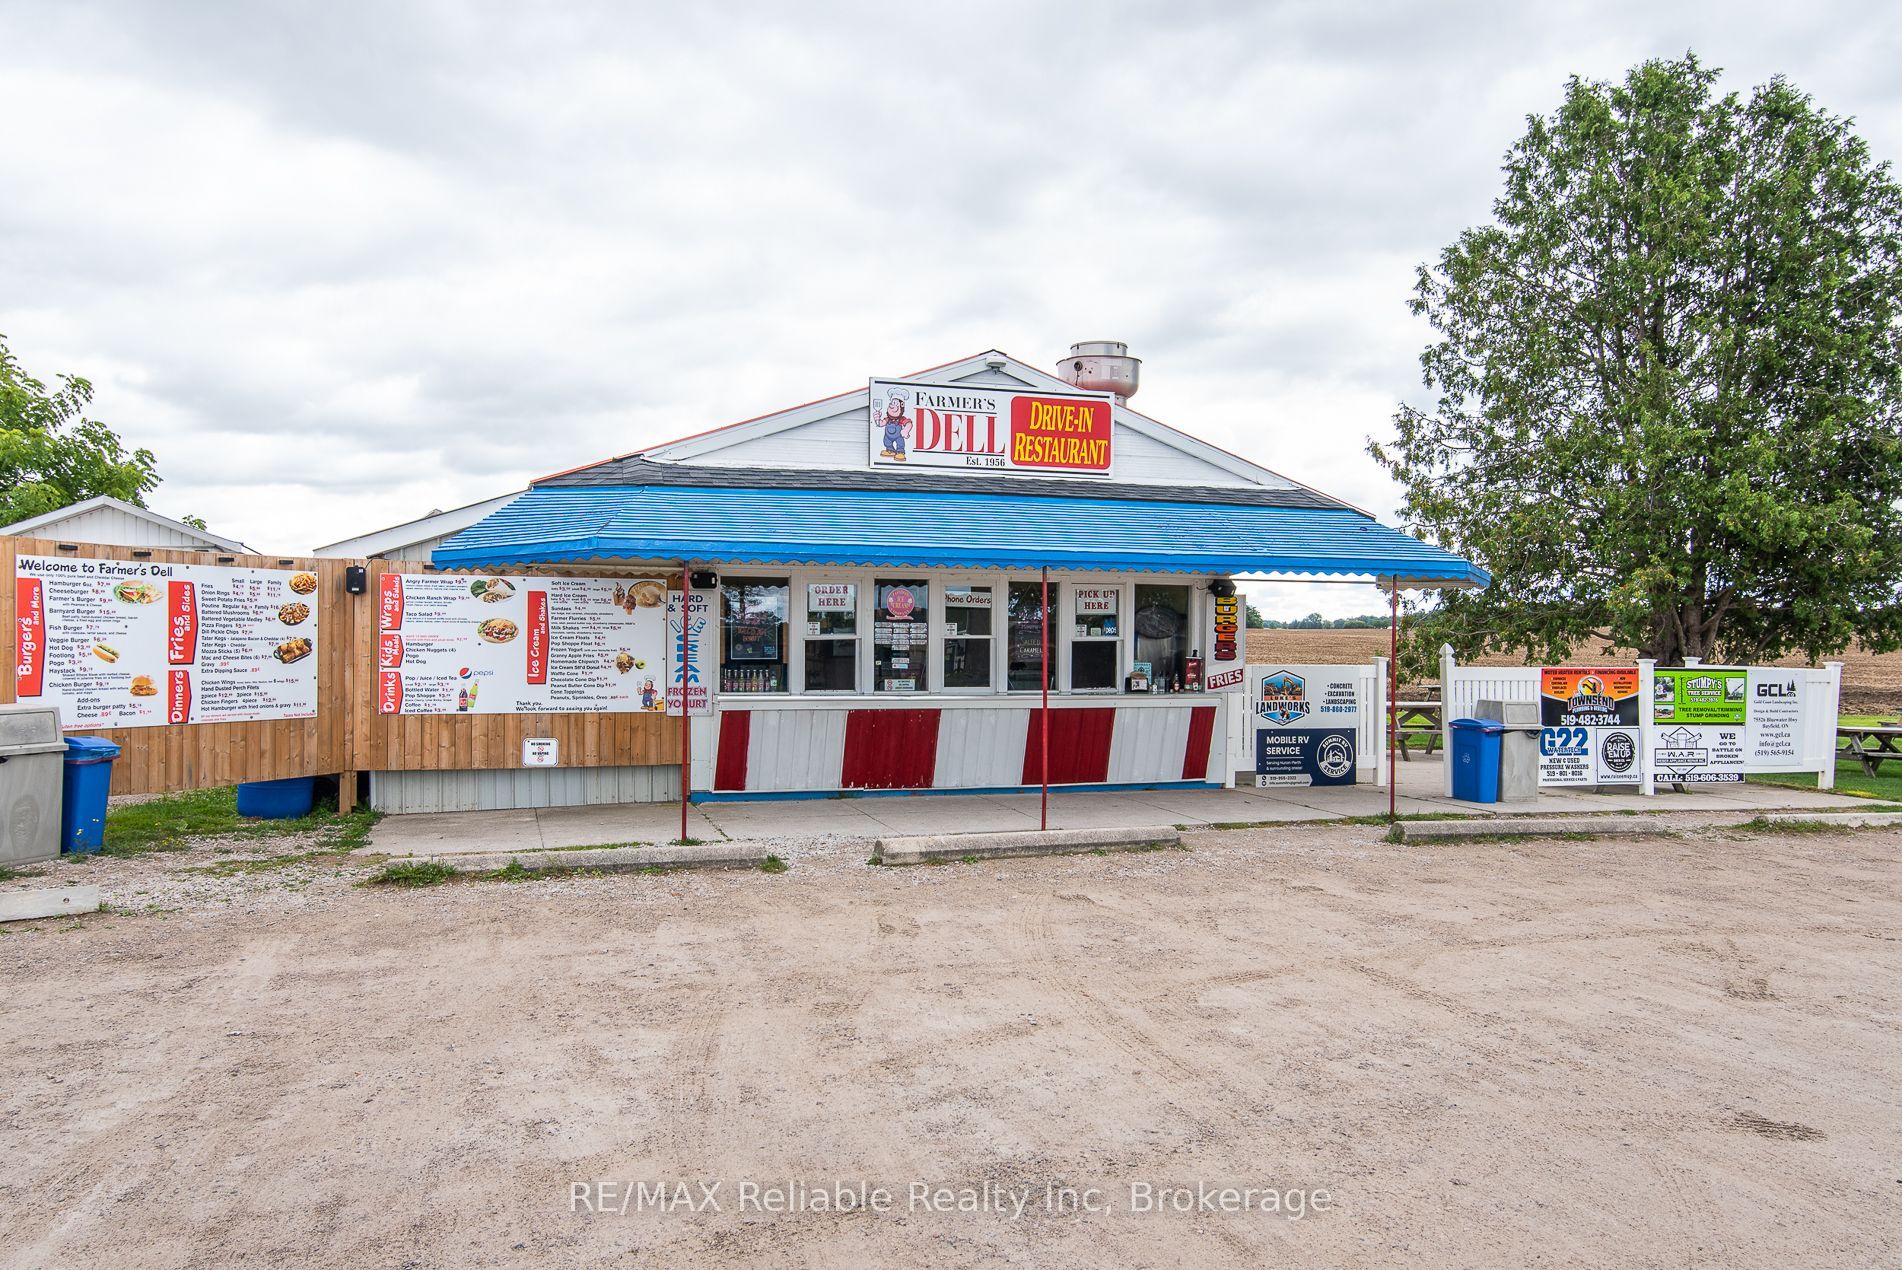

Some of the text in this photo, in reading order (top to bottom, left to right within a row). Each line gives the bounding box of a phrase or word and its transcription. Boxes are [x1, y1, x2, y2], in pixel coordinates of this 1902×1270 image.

[915, 391, 996, 410] FARMER'S
[1029, 401, 1095, 433] DRIVE-IN
[913, 407, 1006, 454] DELL
[1013, 432, 1108, 466] RESTAURANT
[966, 456, 1005, 467] Est. 1956
[19, 559, 78, 573] Welcome
[82, 561, 95, 574] to
[99, 562, 147, 576] Farmer's
[151, 565, 173, 577] Dell
[182, 584, 191, 612] Sides
[814, 585, 848, 594] ORDER
[30, 586, 40, 626] and More
[668, 604, 676, 612] &
[818, 598, 846, 606] HERE
[966, 594, 992, 604] Orders
[381, 590, 392, 629] Wraps
[1214, 597, 1238, 660] BURGERS
[17, 617, 37, 677] Burgers
[169, 617, 185, 661] Fries
[380, 640, 393, 666] Kids
[528, 628, 540, 678] Ice Cream
[1210, 670, 1242, 688] FRIES
[1687, 676, 1722, 689] STUMPY'S
[172, 672, 184, 722] Dinners
[382, 672, 396, 713] Drinks
[1757, 684, 1786, 696] GCL
[668, 700, 708, 708] YOURT
[1256, 702, 1310, 714] LANDWORKS
[1568, 694, 1615, 711] TOWNSEND
[1266, 736, 1296, 744] MOBILE
[1322, 738, 1348, 748] SUMMIT RV
[1540, 728, 1588, 756] G22
[1266, 747, 1300, 755] SERVICE
[1324, 764, 1347, 774] SERVICE
